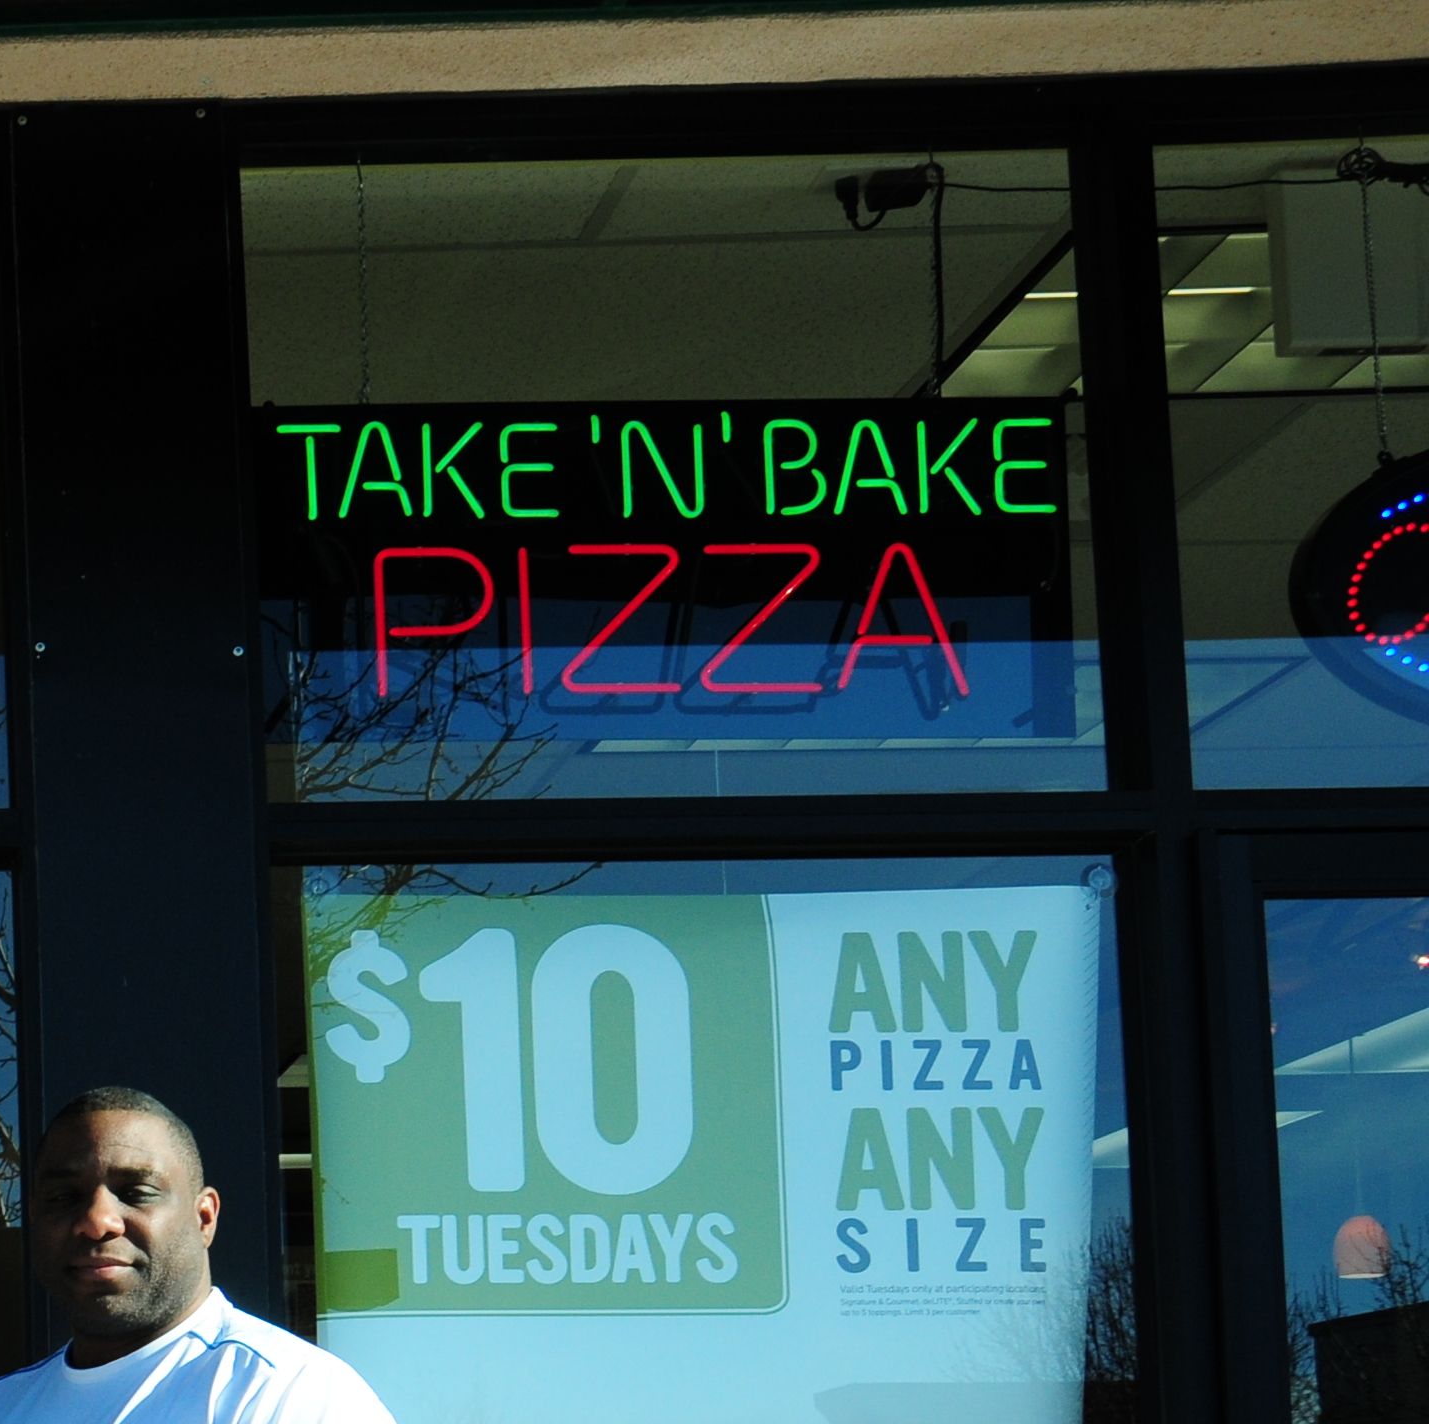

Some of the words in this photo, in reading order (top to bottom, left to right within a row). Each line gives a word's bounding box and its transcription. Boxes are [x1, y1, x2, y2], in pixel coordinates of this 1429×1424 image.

[277, 421, 560, 520] TAKE
[763, 417, 1057, 516] BAKE
[372, 543, 970, 697] PIZZA
[828, 929, 1038, 1034] ANY
[325, 923, 694, 1196] $10
[830, 1039, 1044, 1092] PIZZA
[835, 1106, 1045, 1212] ANY
[397, 1213, 739, 1286] TUESDAYS
[836, 1217, 1048, 1274] SIZE
